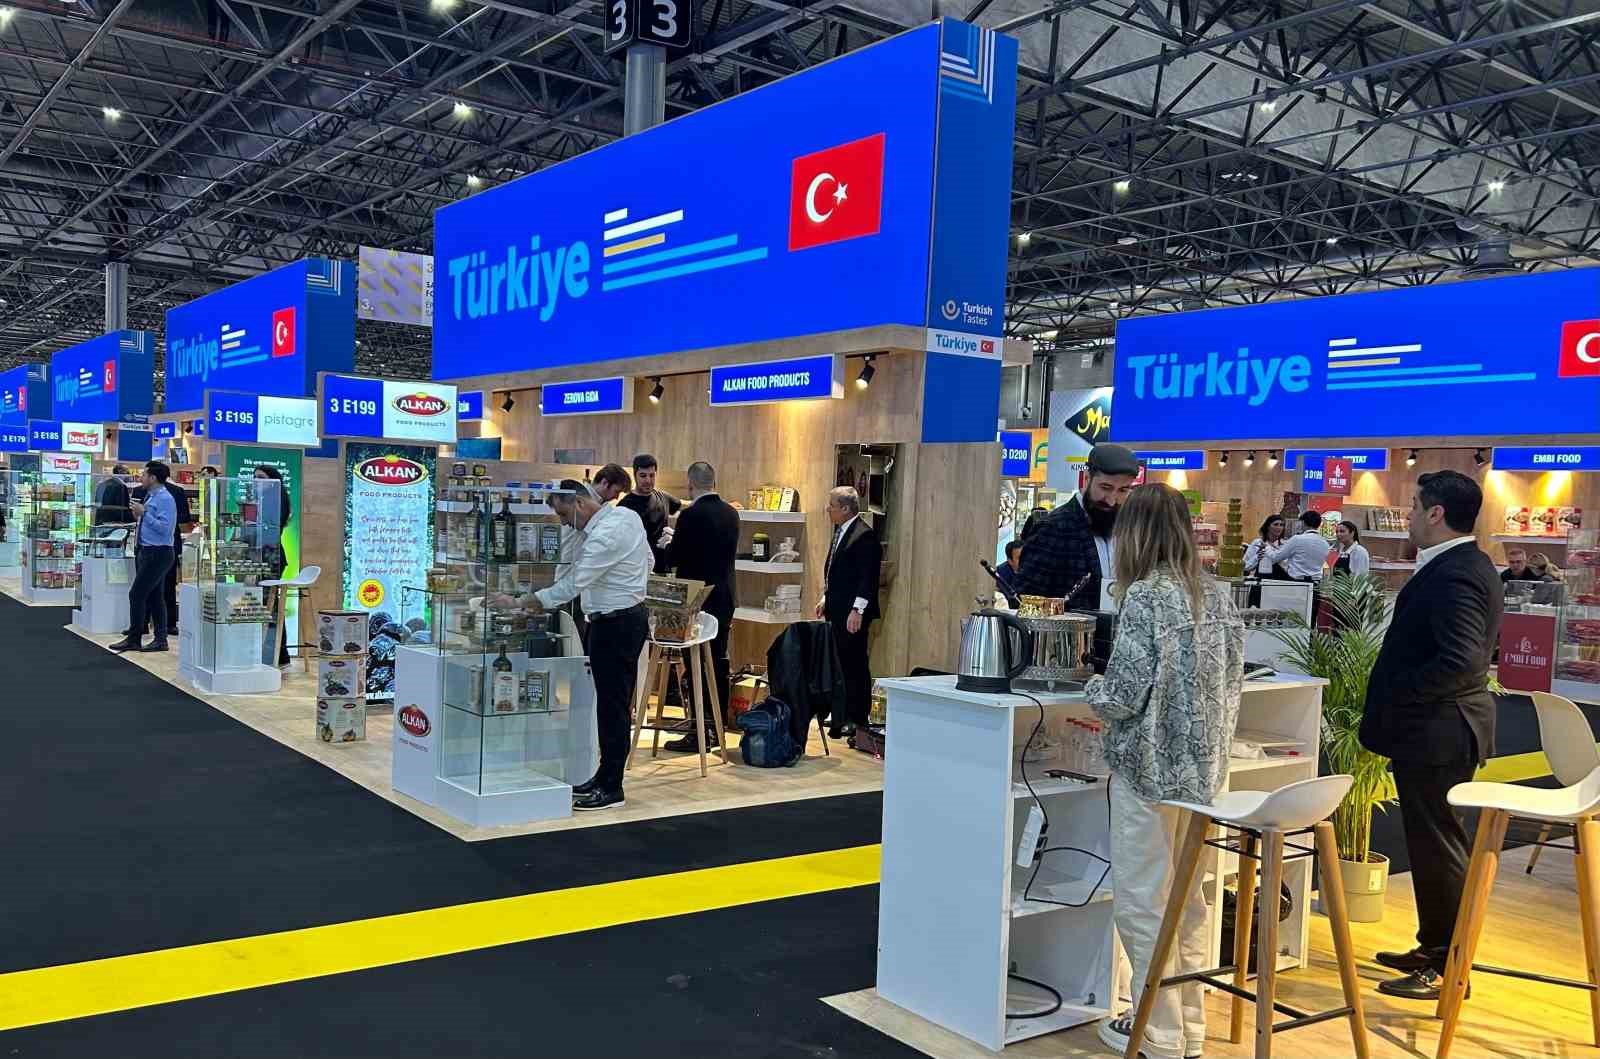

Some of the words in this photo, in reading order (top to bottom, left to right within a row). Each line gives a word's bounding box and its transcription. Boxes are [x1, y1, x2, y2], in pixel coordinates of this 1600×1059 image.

[611, 0, 627, 40] 3
[652, 0, 677, 38] 3
[448, 235, 590, 322] Türkiye
[962, 302, 993, 316] Turkish
[963, 313, 988, 326] Tastes
[935, 334, 977, 353] Türkiye
[171, 333, 218, 382] Türkiye
[723, 378, 746, 392] ALKAN
[747, 375, 768, 390] FOOD
[769, 371, 810, 389] PRODUCTS
[1127, 347, 1312, 406] Türkiye
[330, 398, 339, 414] 3
[343, 399, 376, 415] E199
[399, 400, 441, 411] ALKAN
[215, 410, 223, 422] 3
[226, 411, 254, 424] E195
[1009, 449, 1028, 460] D200
[1533, 454, 1555, 463] EMBI
[1556, 454, 1582, 463] FOOD
[365, 465, 416, 479] ALKAN
[402, 712, 426, 731] ALKAN
